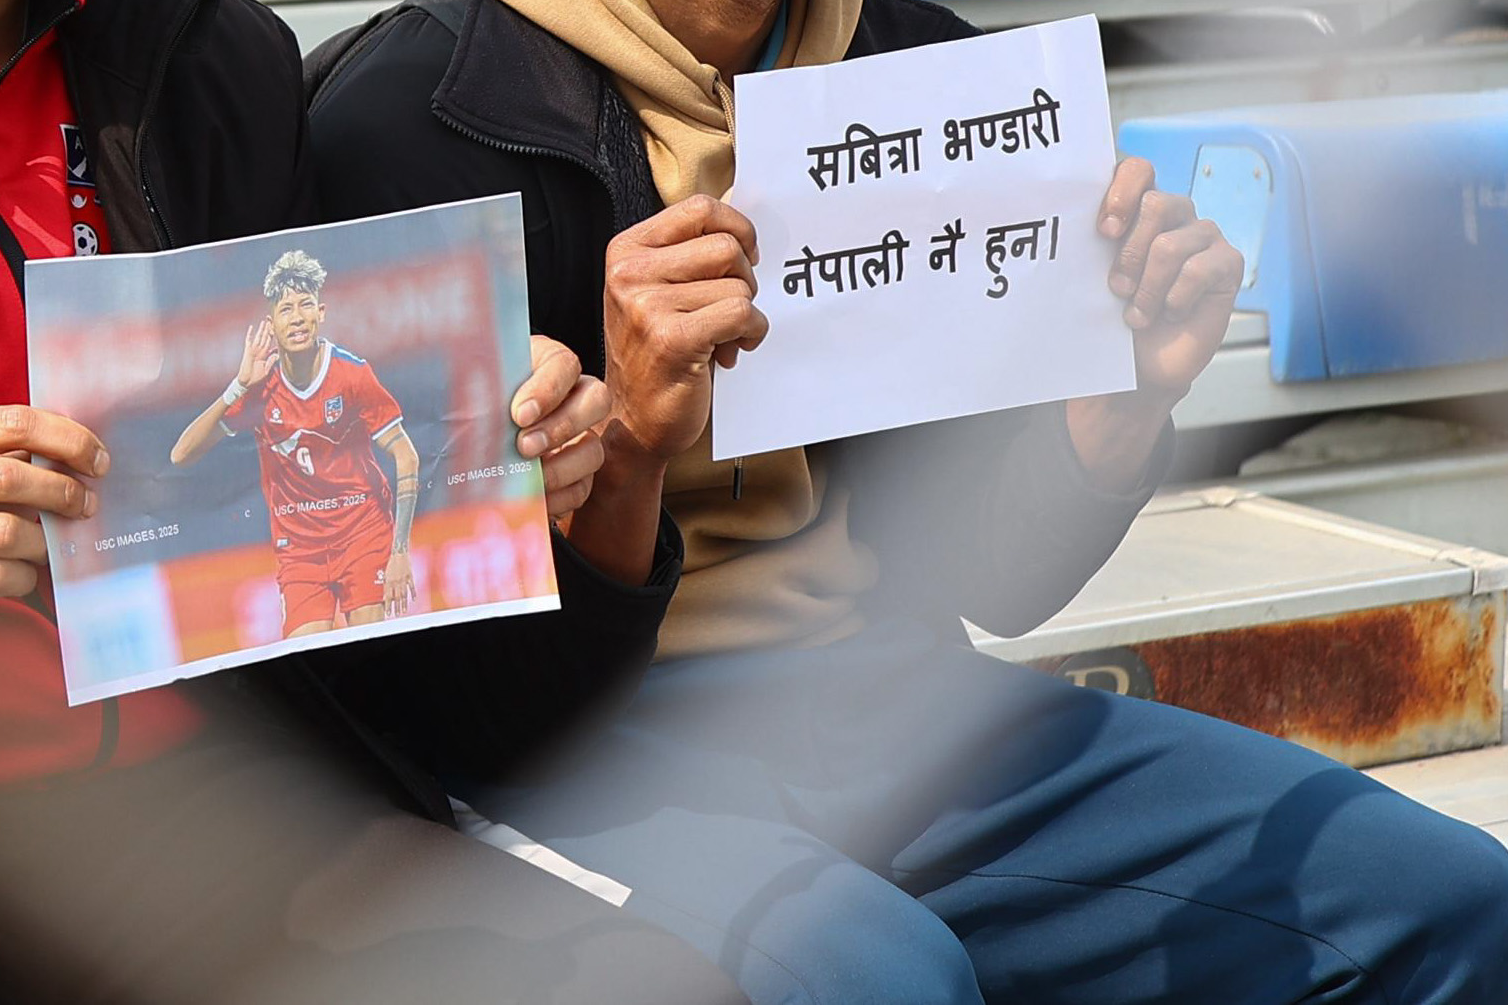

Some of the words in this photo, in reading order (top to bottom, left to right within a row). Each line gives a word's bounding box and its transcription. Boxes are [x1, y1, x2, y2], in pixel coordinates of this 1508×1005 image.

[806, 123, 923, 191] सबित्रा
[943, 88, 1061, 162] भण्डारी
[783, 229, 910, 298] नेपाली
[929, 218, 966, 273] नै
[296, 447, 315, 476] 9
[447, 473, 466, 486] USC
[509, 461, 532, 474] 2025
[274, 504, 295, 517] USC
[343, 494, 367, 507] 2025
[94, 538, 115, 551] USC
[158, 524, 179, 538] 2025
